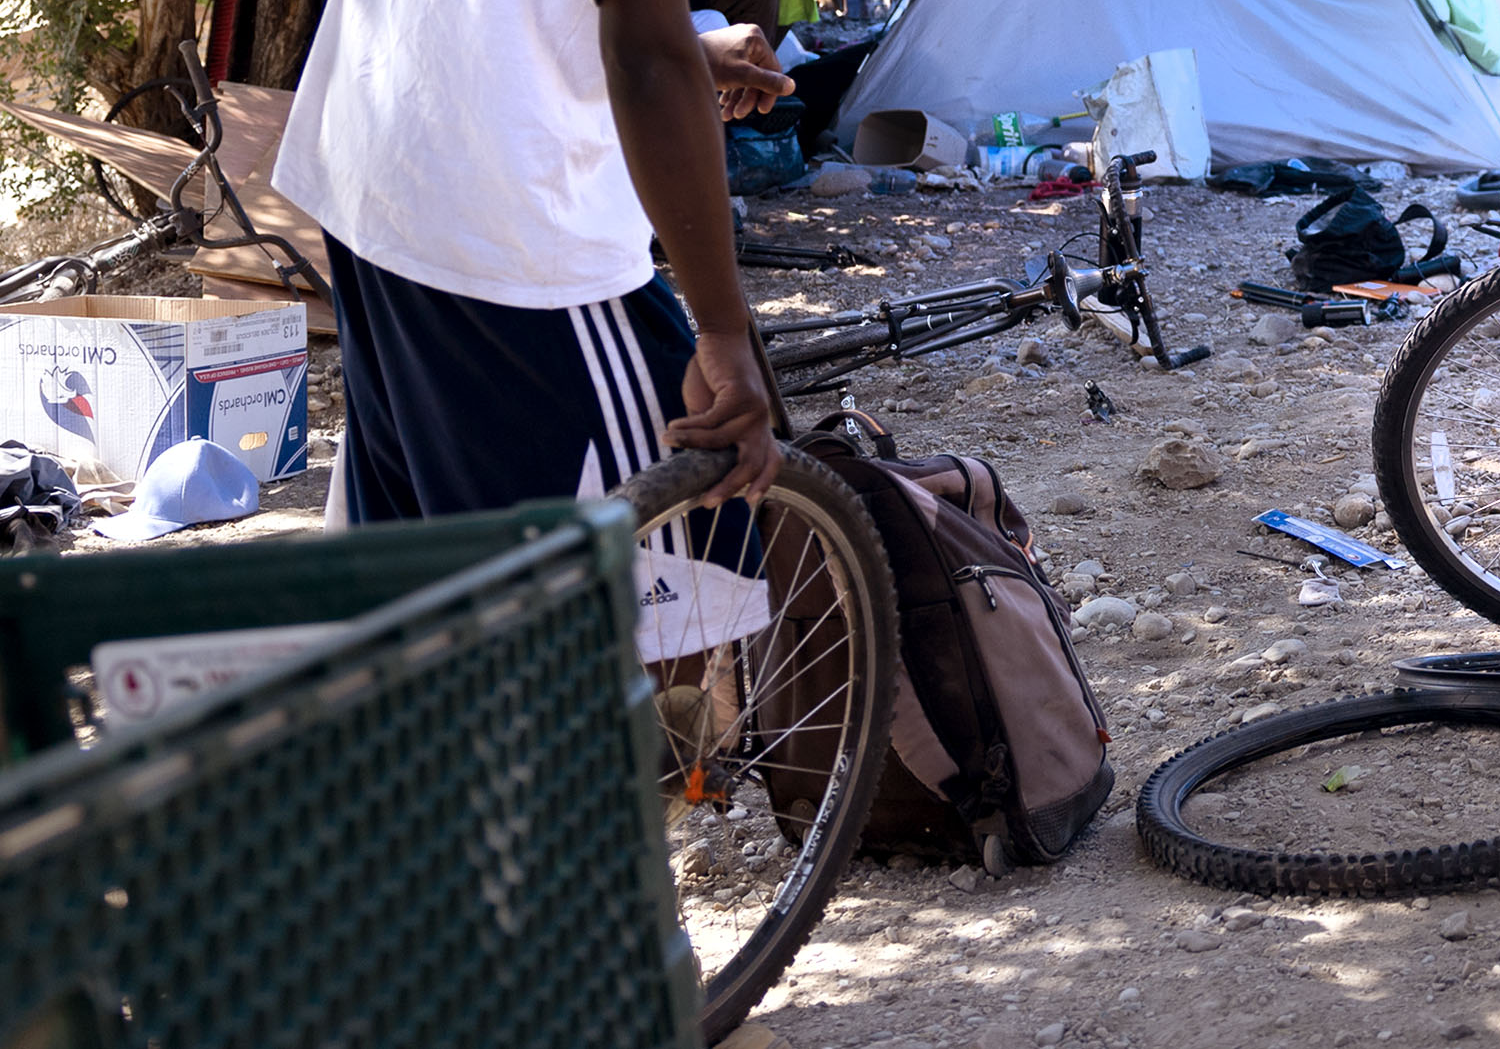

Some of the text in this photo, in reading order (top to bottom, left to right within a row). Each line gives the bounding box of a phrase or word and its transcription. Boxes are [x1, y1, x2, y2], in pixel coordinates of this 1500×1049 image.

[283, 324, 300, 339] 113
[18, 343, 117, 365] CMI orchards
[219, 389, 286, 416] CMI orchards
[640, 592, 679, 607] addas
